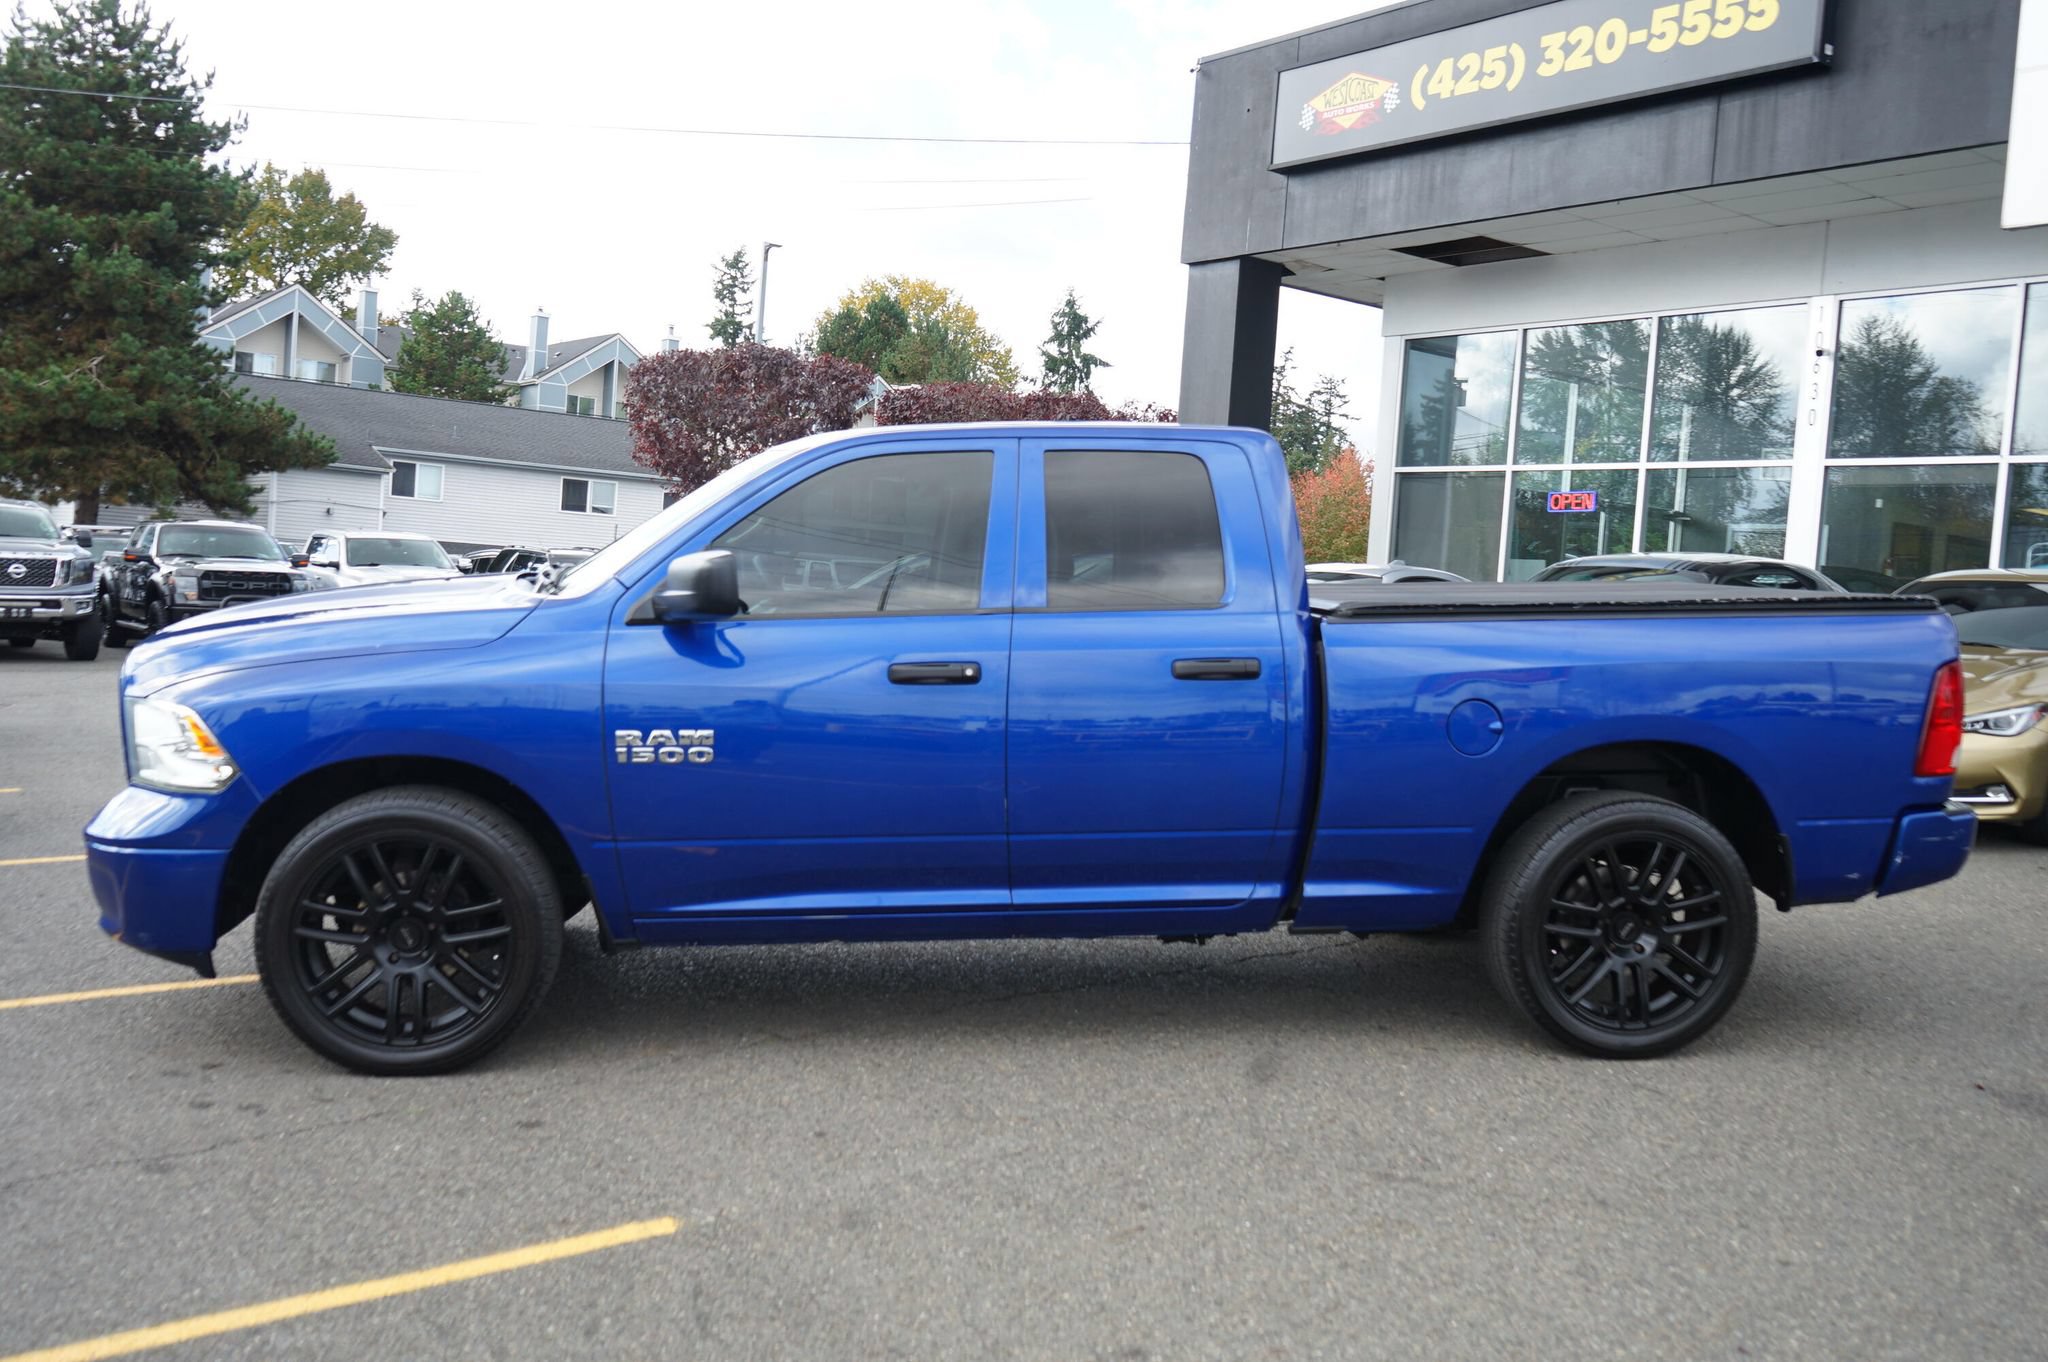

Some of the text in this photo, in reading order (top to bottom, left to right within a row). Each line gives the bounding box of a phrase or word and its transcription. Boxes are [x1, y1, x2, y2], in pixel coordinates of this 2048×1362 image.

[1411, 0, 1780, 111] (425) 320-5555
[1322, 101, 1375, 119] AUTO WORKS
[1551, 493, 1594, 510] OPEN
[615, 729, 715, 746] RAM
[615, 746, 714, 763] 1500
